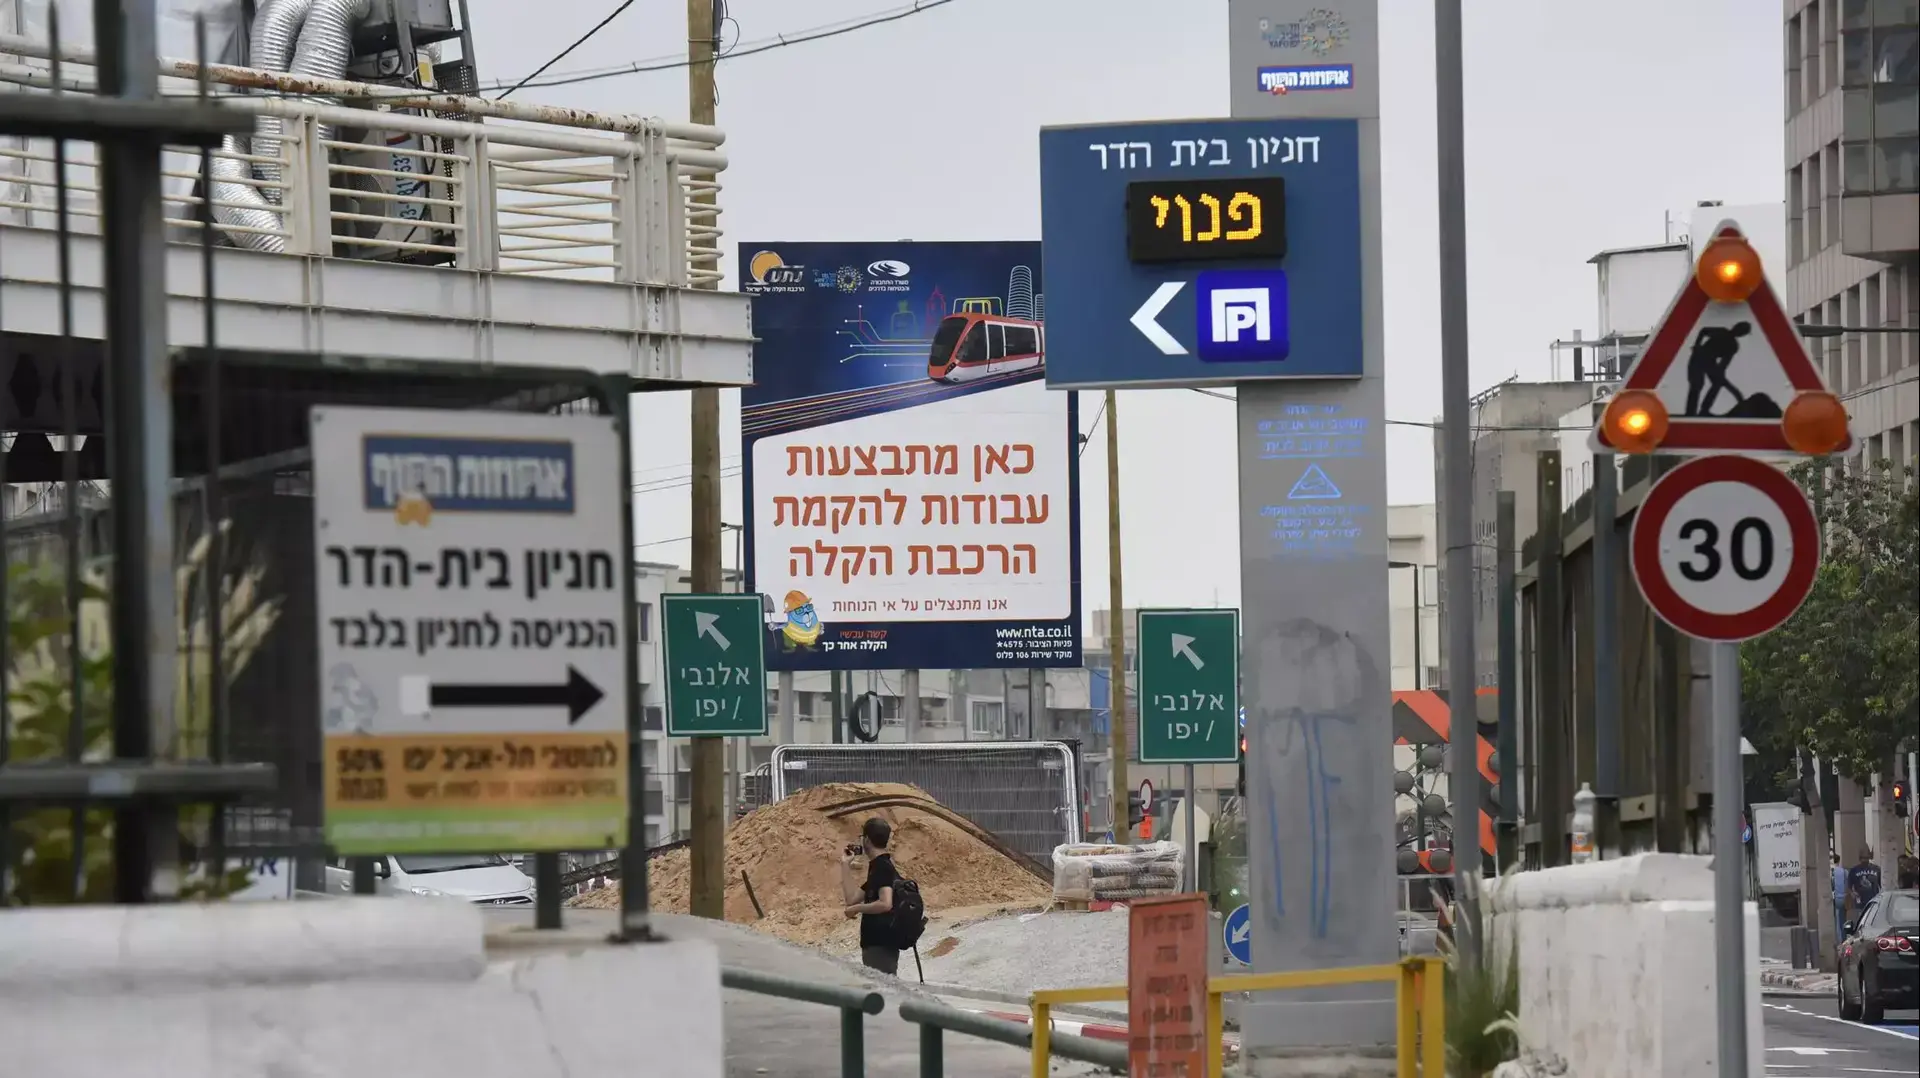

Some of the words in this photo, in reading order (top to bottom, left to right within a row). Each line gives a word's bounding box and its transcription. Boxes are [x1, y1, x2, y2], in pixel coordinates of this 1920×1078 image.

[1089, 142, 1151, 170] הדר
[1171, 138, 1231, 167] בית
[1247, 136, 1320, 168] חניון
[1150, 191, 1262, 242] פנוי
[786, 444, 958, 476] מתבצעות
[974, 444, 1035, 482] כאן
[773, 488, 907, 534] להקמת
[921, 494, 1049, 525] עבודות
[907, 543, 1036, 575] הרכבת
[1678, 516, 1774, 582] 30
[326, 545, 511, 589] בית-הדר
[790, 539, 893, 584] הקלה
[526, 549, 614, 600] חניון
[832, 600, 877, 612] הנוחות
[883, 600, 896, 611] אי
[901, 598, 919, 612] על
[925, 597, 981, 611] מתנצלים
[987, 599, 1008, 611] אנו
[330, 611, 408, 649] בלבד
[416, 612, 501, 656] לחניון
[511, 618, 617, 649] הכניסה
[840, 630, 865, 639] עכשיו
[866, 629, 888, 640] קשה
[996, 625, 1072, 638] www.nta.co.il
[822, 641, 835, 652] כך
[837, 641, 858, 650] אחר
[860, 640, 888, 651] הקלה
[996, 651, 1014, 659] פלוס
[1015, 651, 1029, 659] 106
[1031, 651, 1052, 659] שירות
[1053, 640, 1072, 648] פניות
[1054, 651, 1072, 659] מוקד
[681, 661, 750, 686] אלנבי
[1154, 689, 1224, 711] אלנבי
[1772, 860, 1799, 869] תל-אביב
